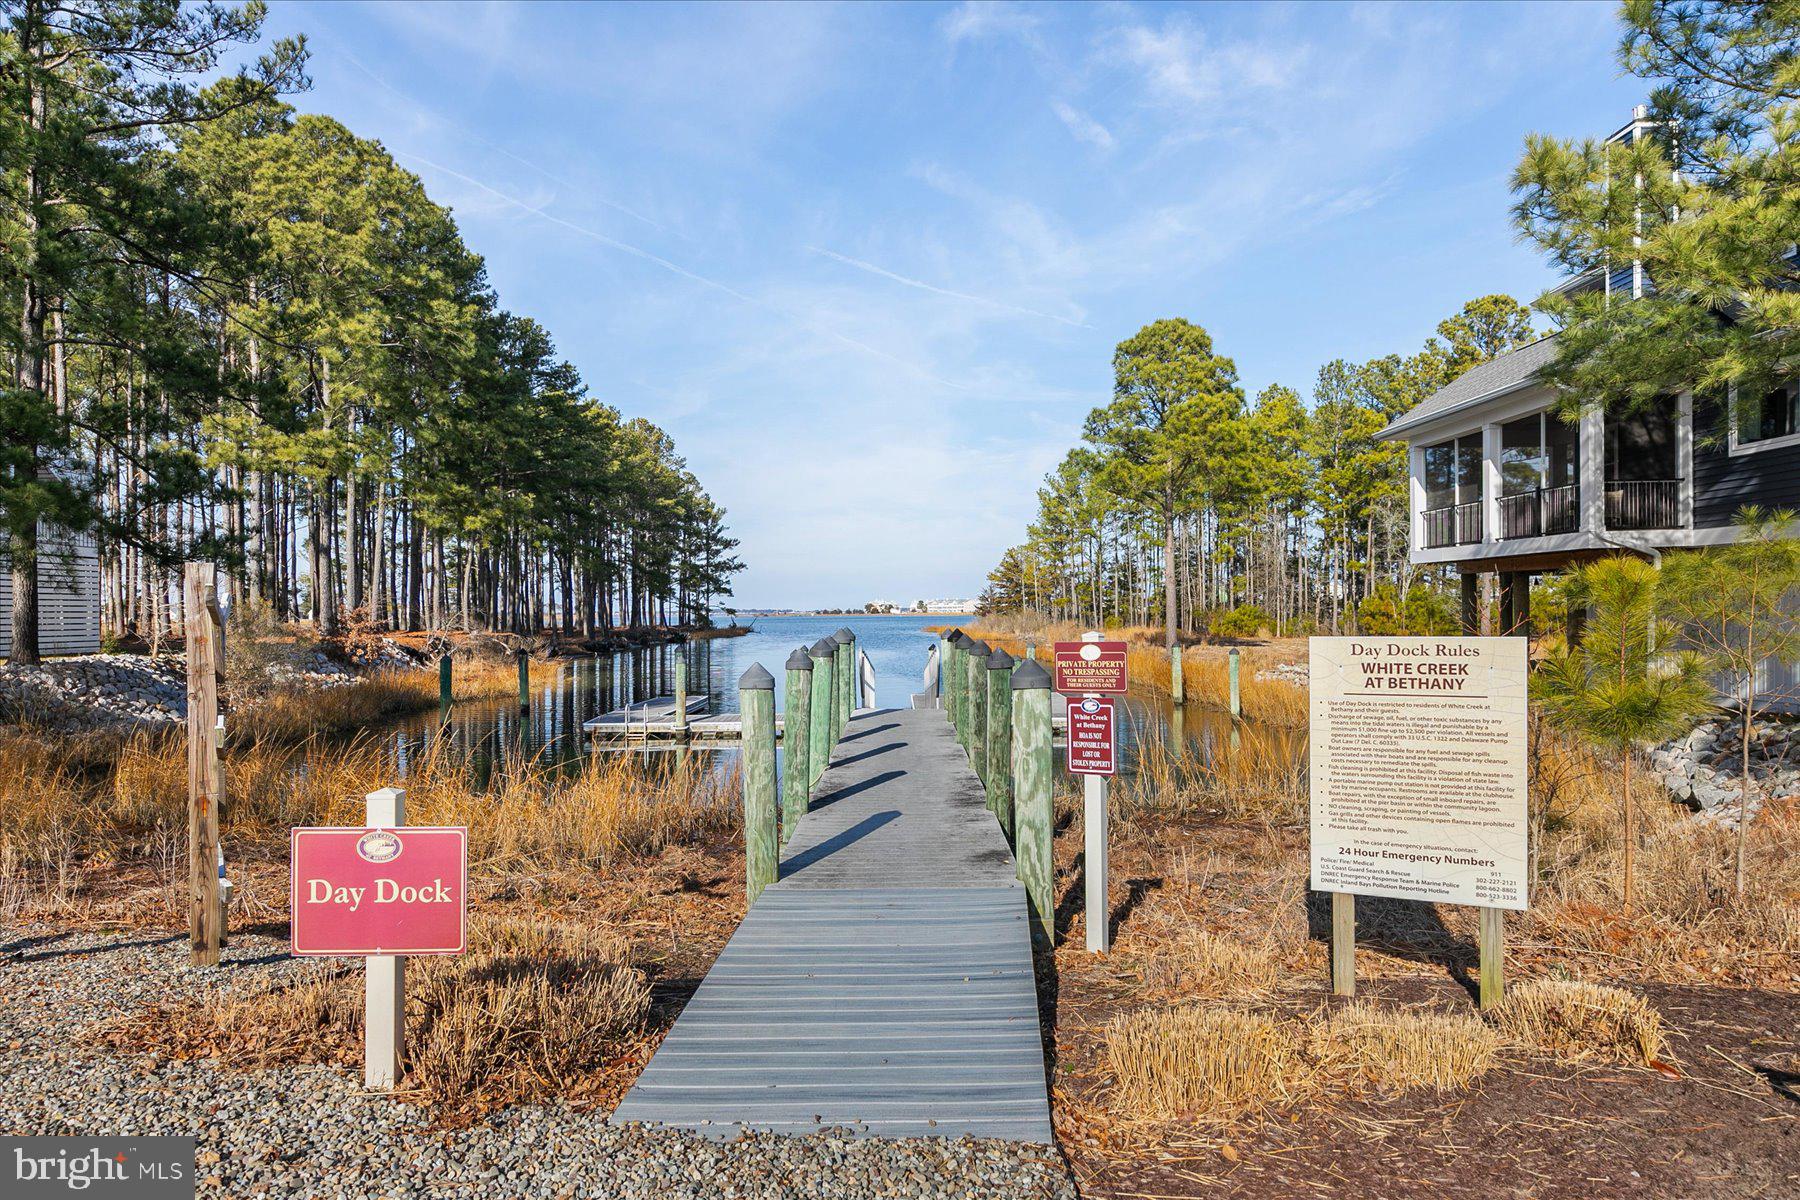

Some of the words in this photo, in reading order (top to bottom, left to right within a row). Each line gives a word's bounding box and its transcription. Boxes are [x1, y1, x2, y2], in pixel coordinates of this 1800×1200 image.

[1350, 643, 1382, 659] Day
[1387, 644, 1430, 656] Dock
[1435, 644, 1480, 657] Rules
[1361, 662, 1413, 675] WHITE
[1417, 663, 1469, 676] CREEK
[1364, 677, 1384, 689] AT
[1388, 677, 1466, 691] BETHANY
[1338, 847, 1351, 856] 24
[1354, 848, 1380, 858] Hour
[1382, 850, 1442, 865] Emergency
[1444, 855, 1495, 867] Numbers
[1340, 873, 1371, 881] Emergency
[306, 878, 366, 912] Day
[374, 878, 452, 904] Dock
[1398, 885, 1427, 893] Reporting
